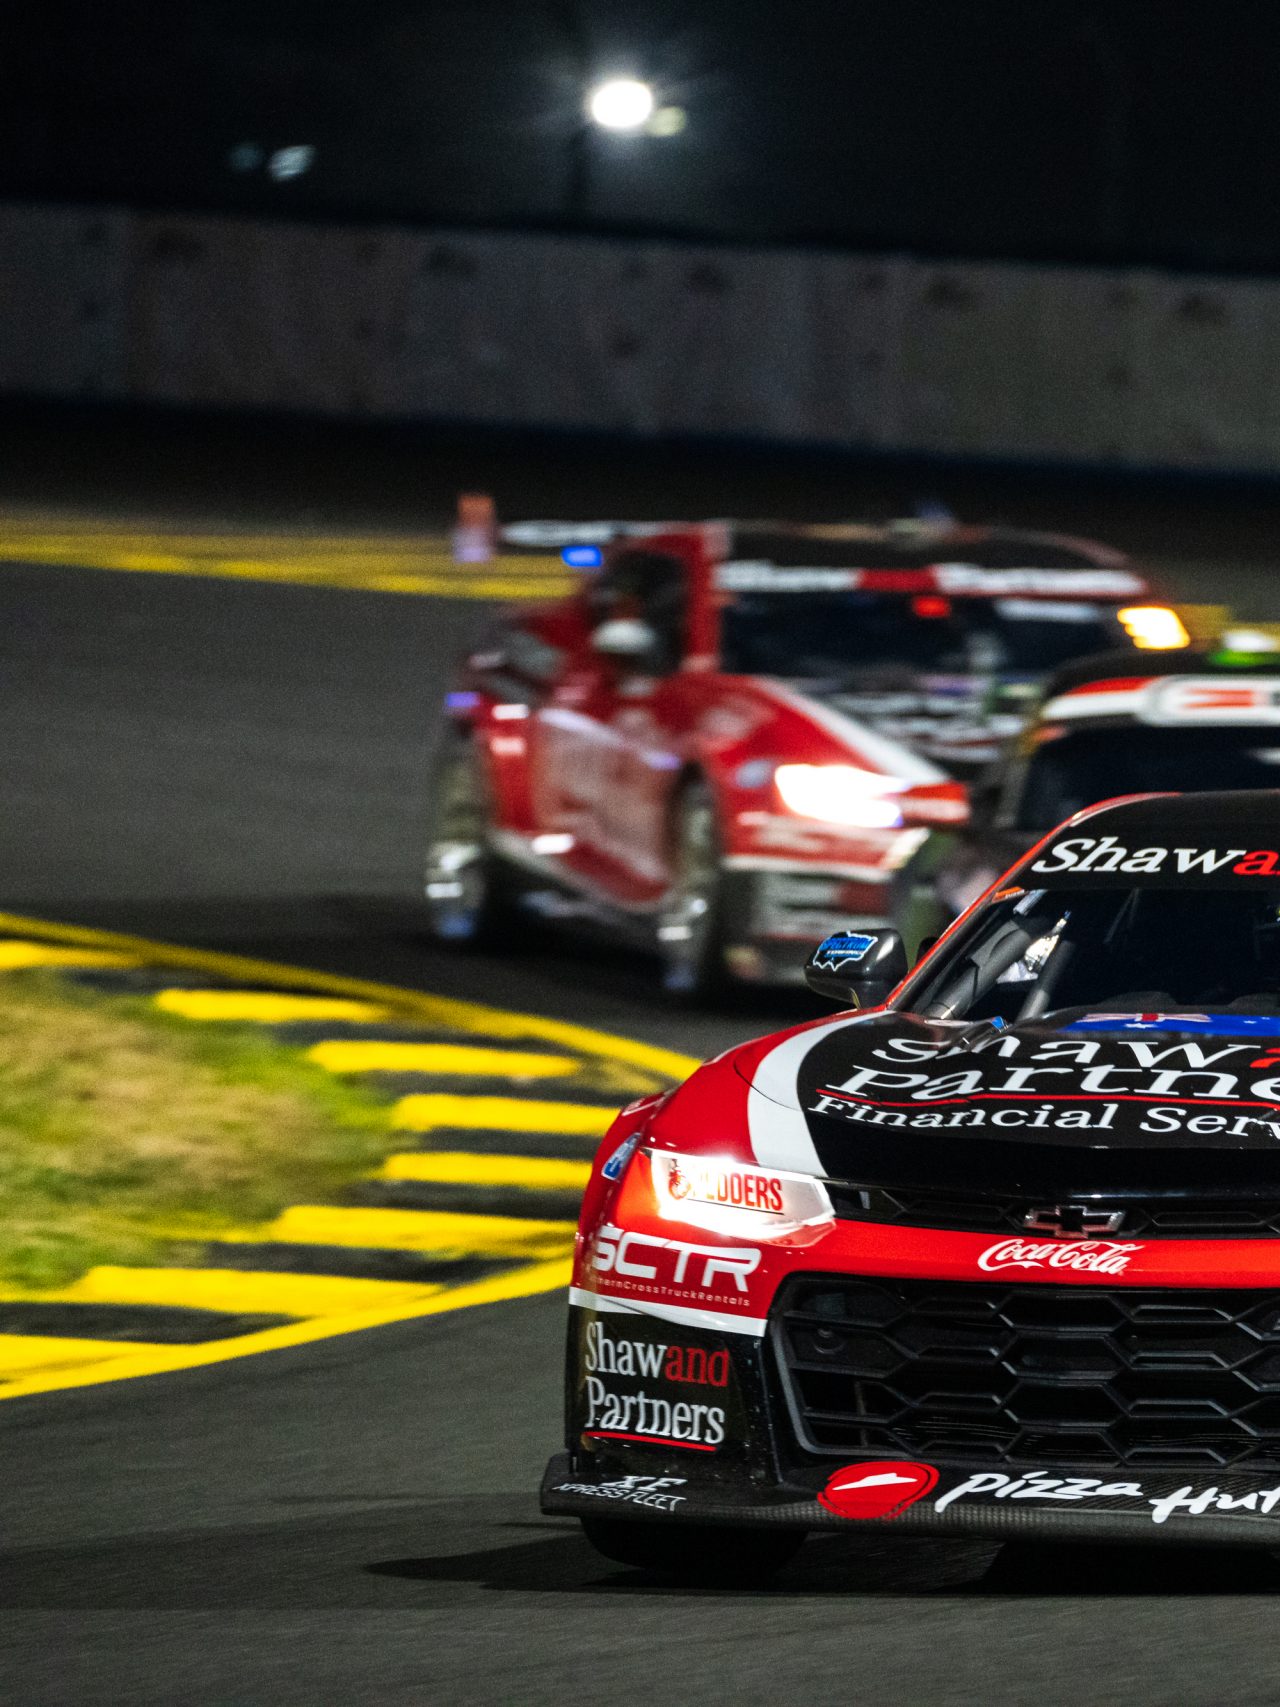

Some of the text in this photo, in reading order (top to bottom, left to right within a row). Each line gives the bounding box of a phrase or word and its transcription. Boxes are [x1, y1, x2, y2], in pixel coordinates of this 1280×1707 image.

[807, 1093, 1119, 1130] Financial
[592, 1226, 762, 1293] SCTR
[584, 1375, 726, 1444] Partners
